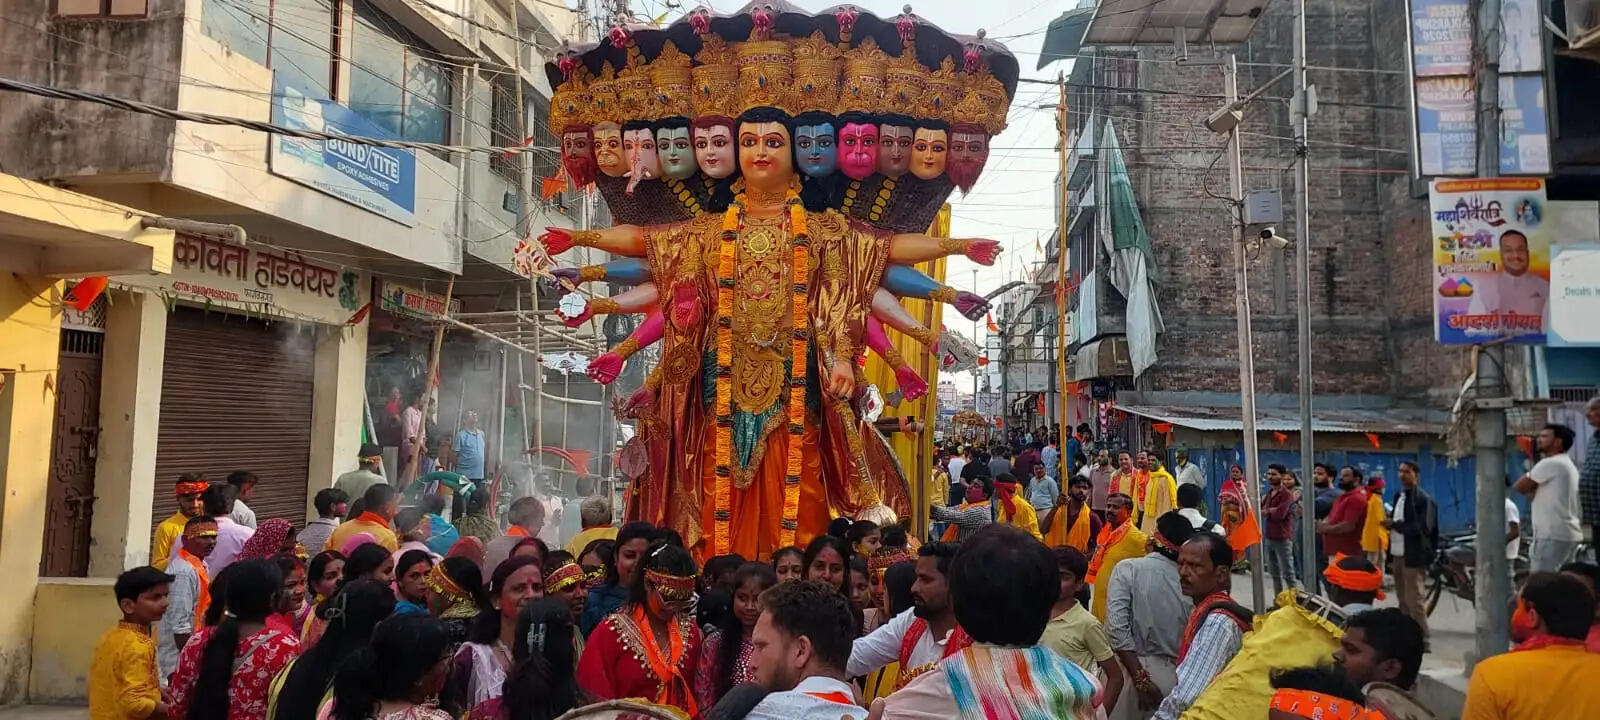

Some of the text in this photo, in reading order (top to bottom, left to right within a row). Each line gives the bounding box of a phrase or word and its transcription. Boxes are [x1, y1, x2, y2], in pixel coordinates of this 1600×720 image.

[337, 161, 389, 191] EPOXY ADHESIVES
[373, 153, 398, 179] TITE
[255, 249, 338, 298] हार्डवेयर
